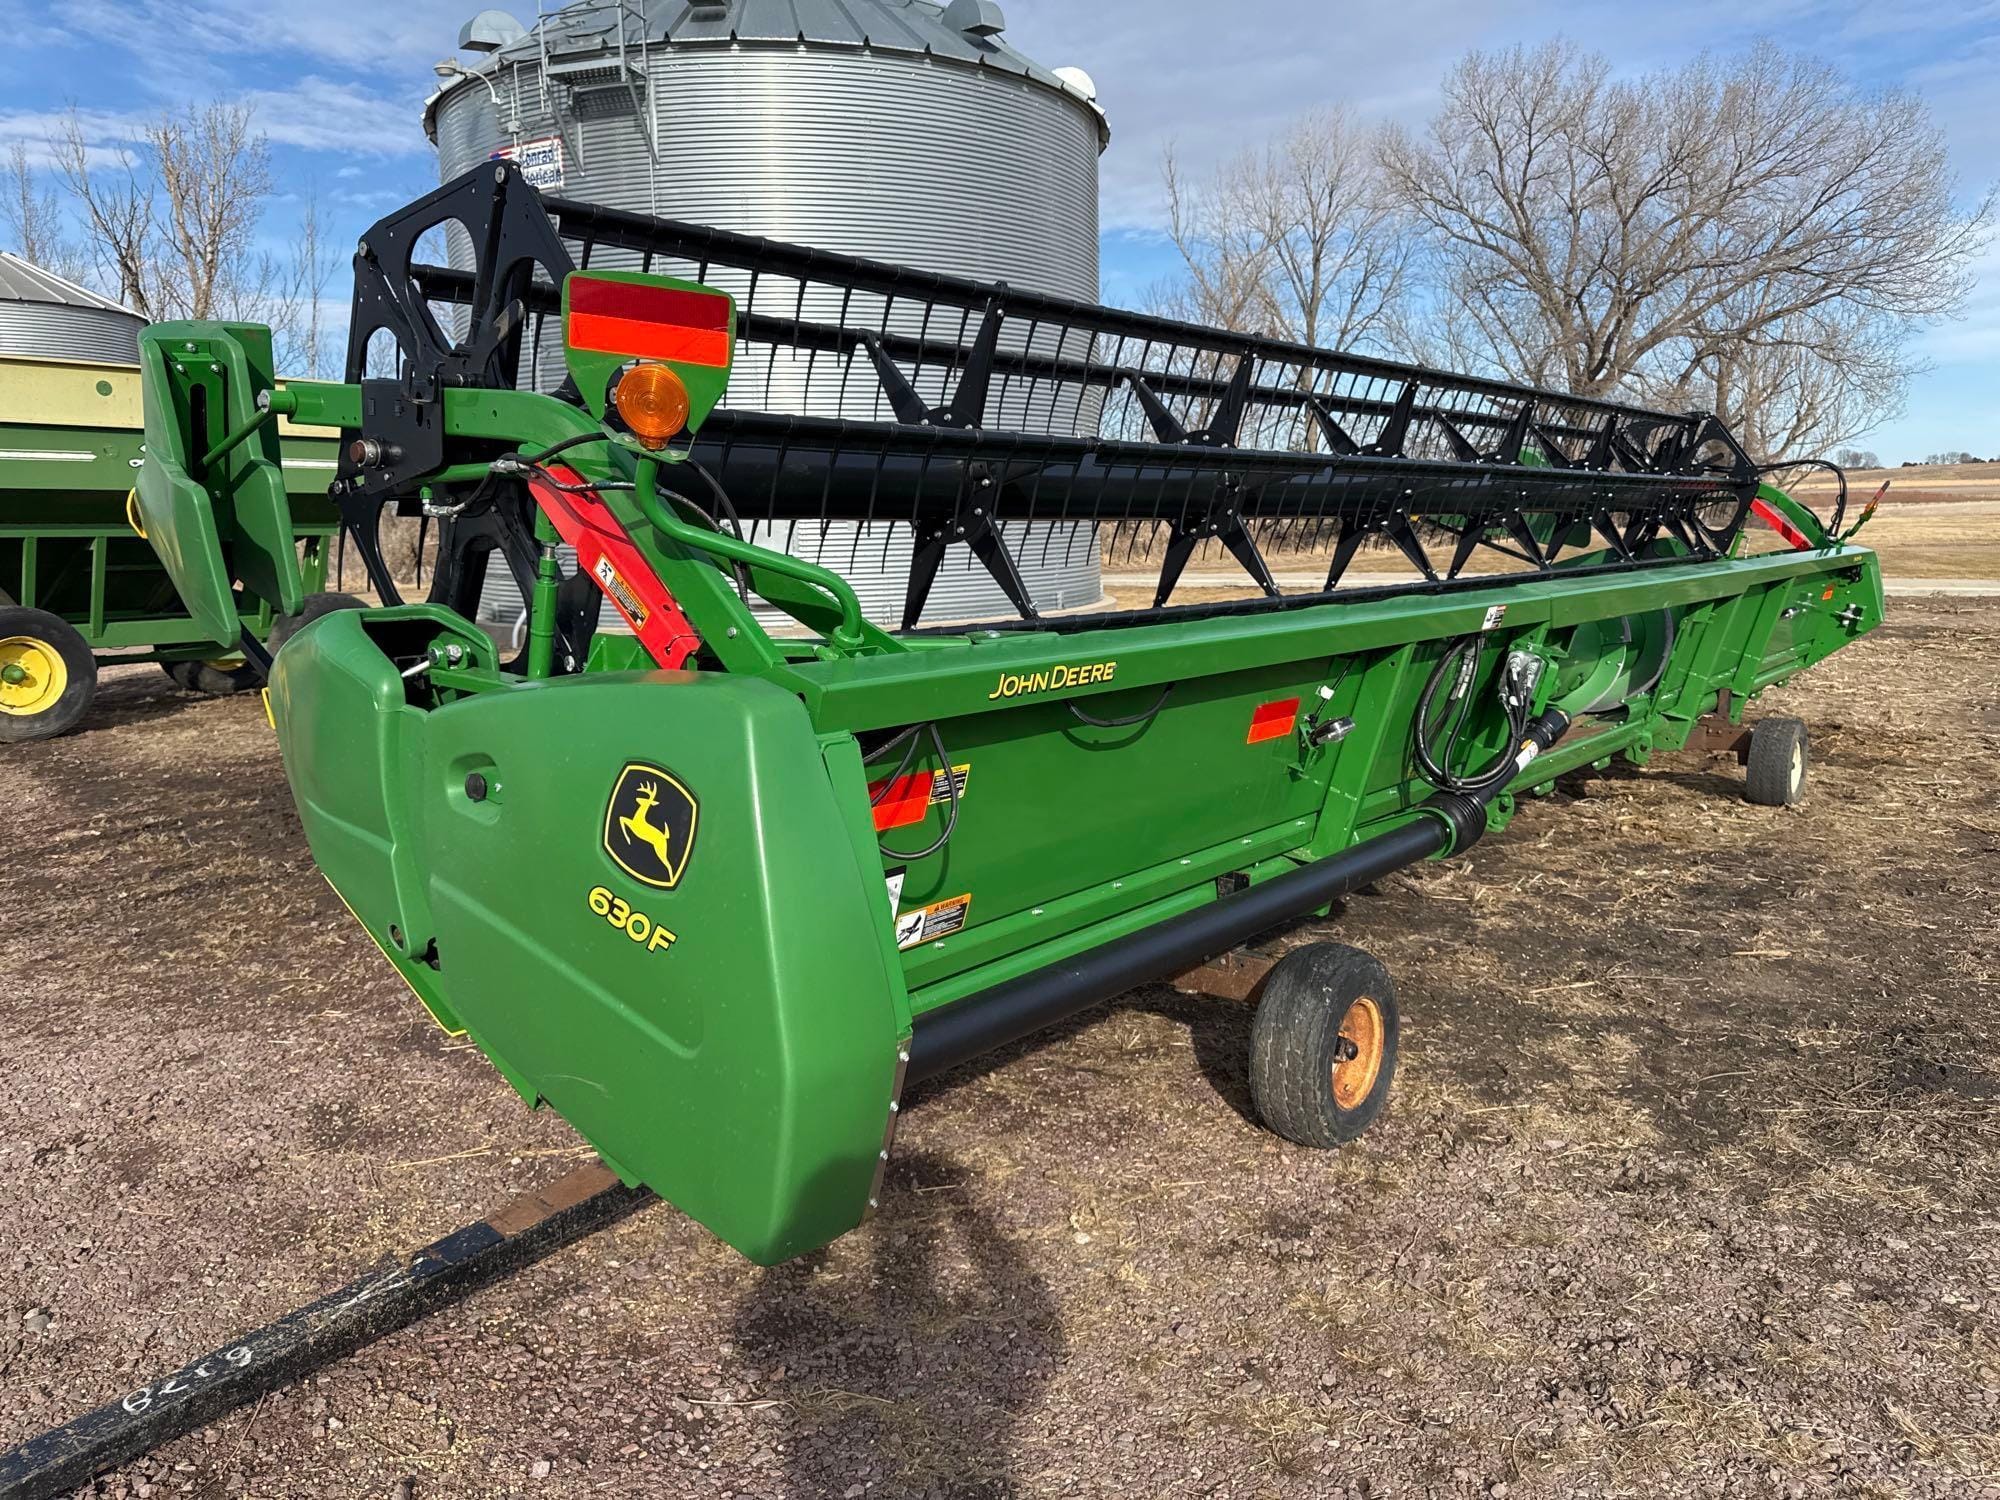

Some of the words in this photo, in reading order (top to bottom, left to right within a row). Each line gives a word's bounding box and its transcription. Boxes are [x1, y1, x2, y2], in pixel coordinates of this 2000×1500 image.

[988, 672, 1049, 700] JOHN
[1050, 661, 1117, 690] DEERE
[587, 885, 678, 954] 630F
